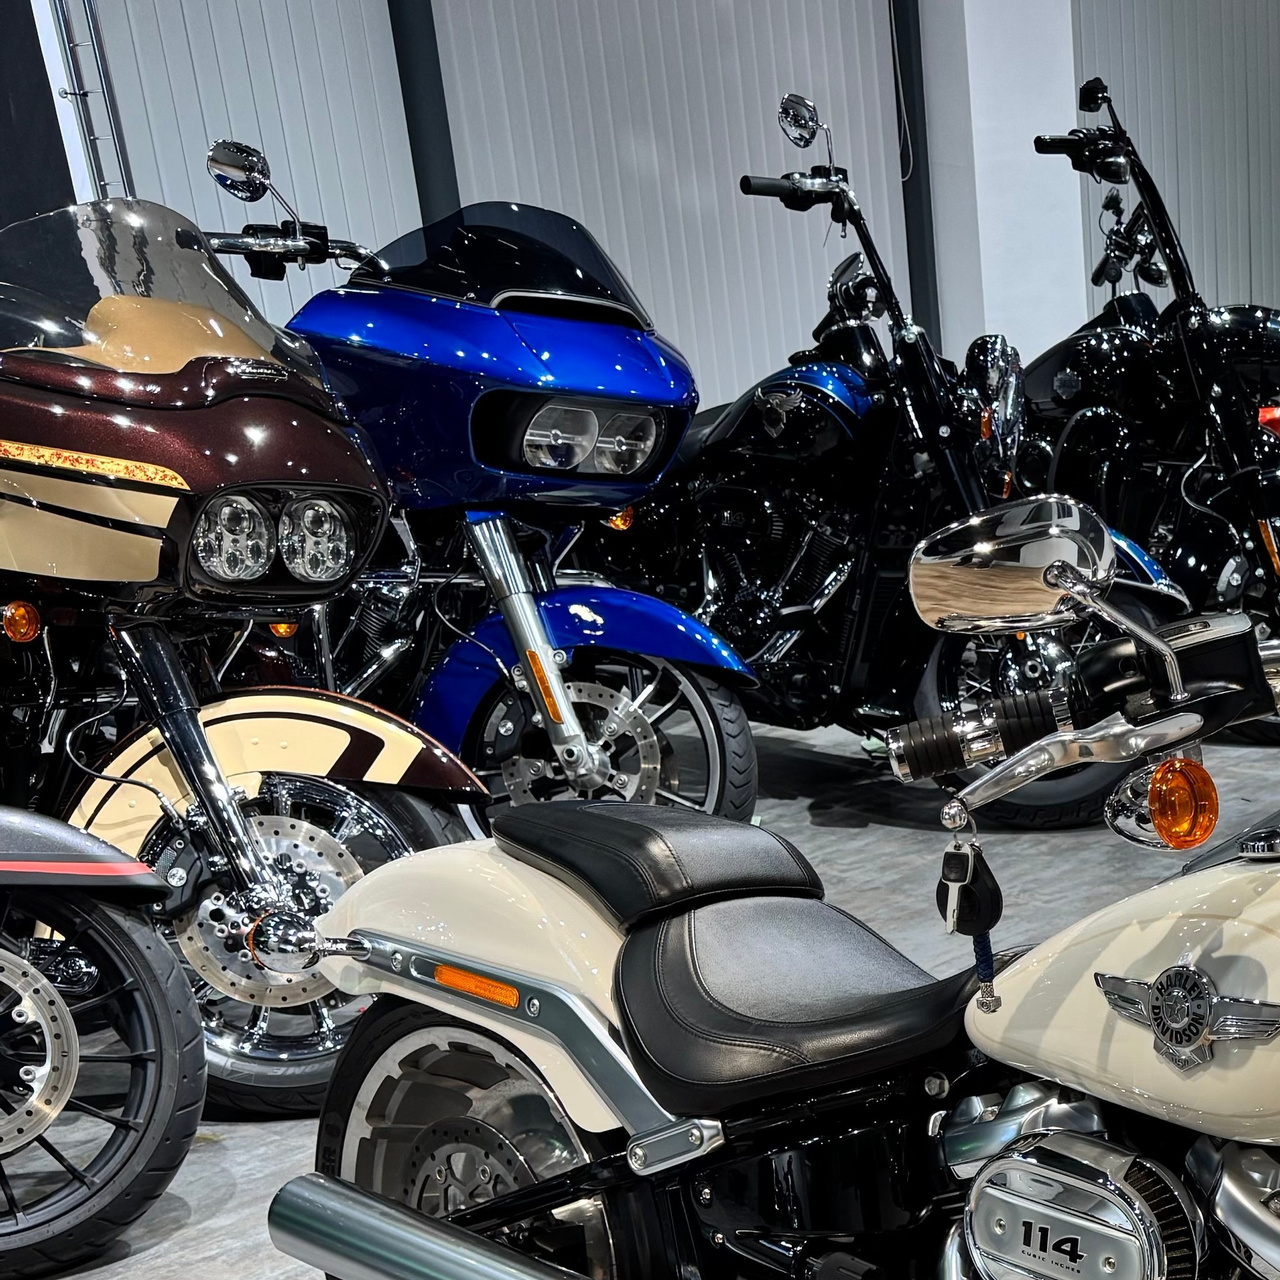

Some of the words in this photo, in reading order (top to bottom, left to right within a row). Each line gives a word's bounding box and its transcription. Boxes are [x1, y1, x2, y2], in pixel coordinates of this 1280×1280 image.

[1155, 971, 1206, 1004] HARLEY
[1151, 1004, 1206, 1045] DAVIDSON
[1021, 1220, 1087, 1265] 114
[1021, 1249, 1046, 1262] CUBIC
[1051, 1260, 1082, 1275] INCHES
